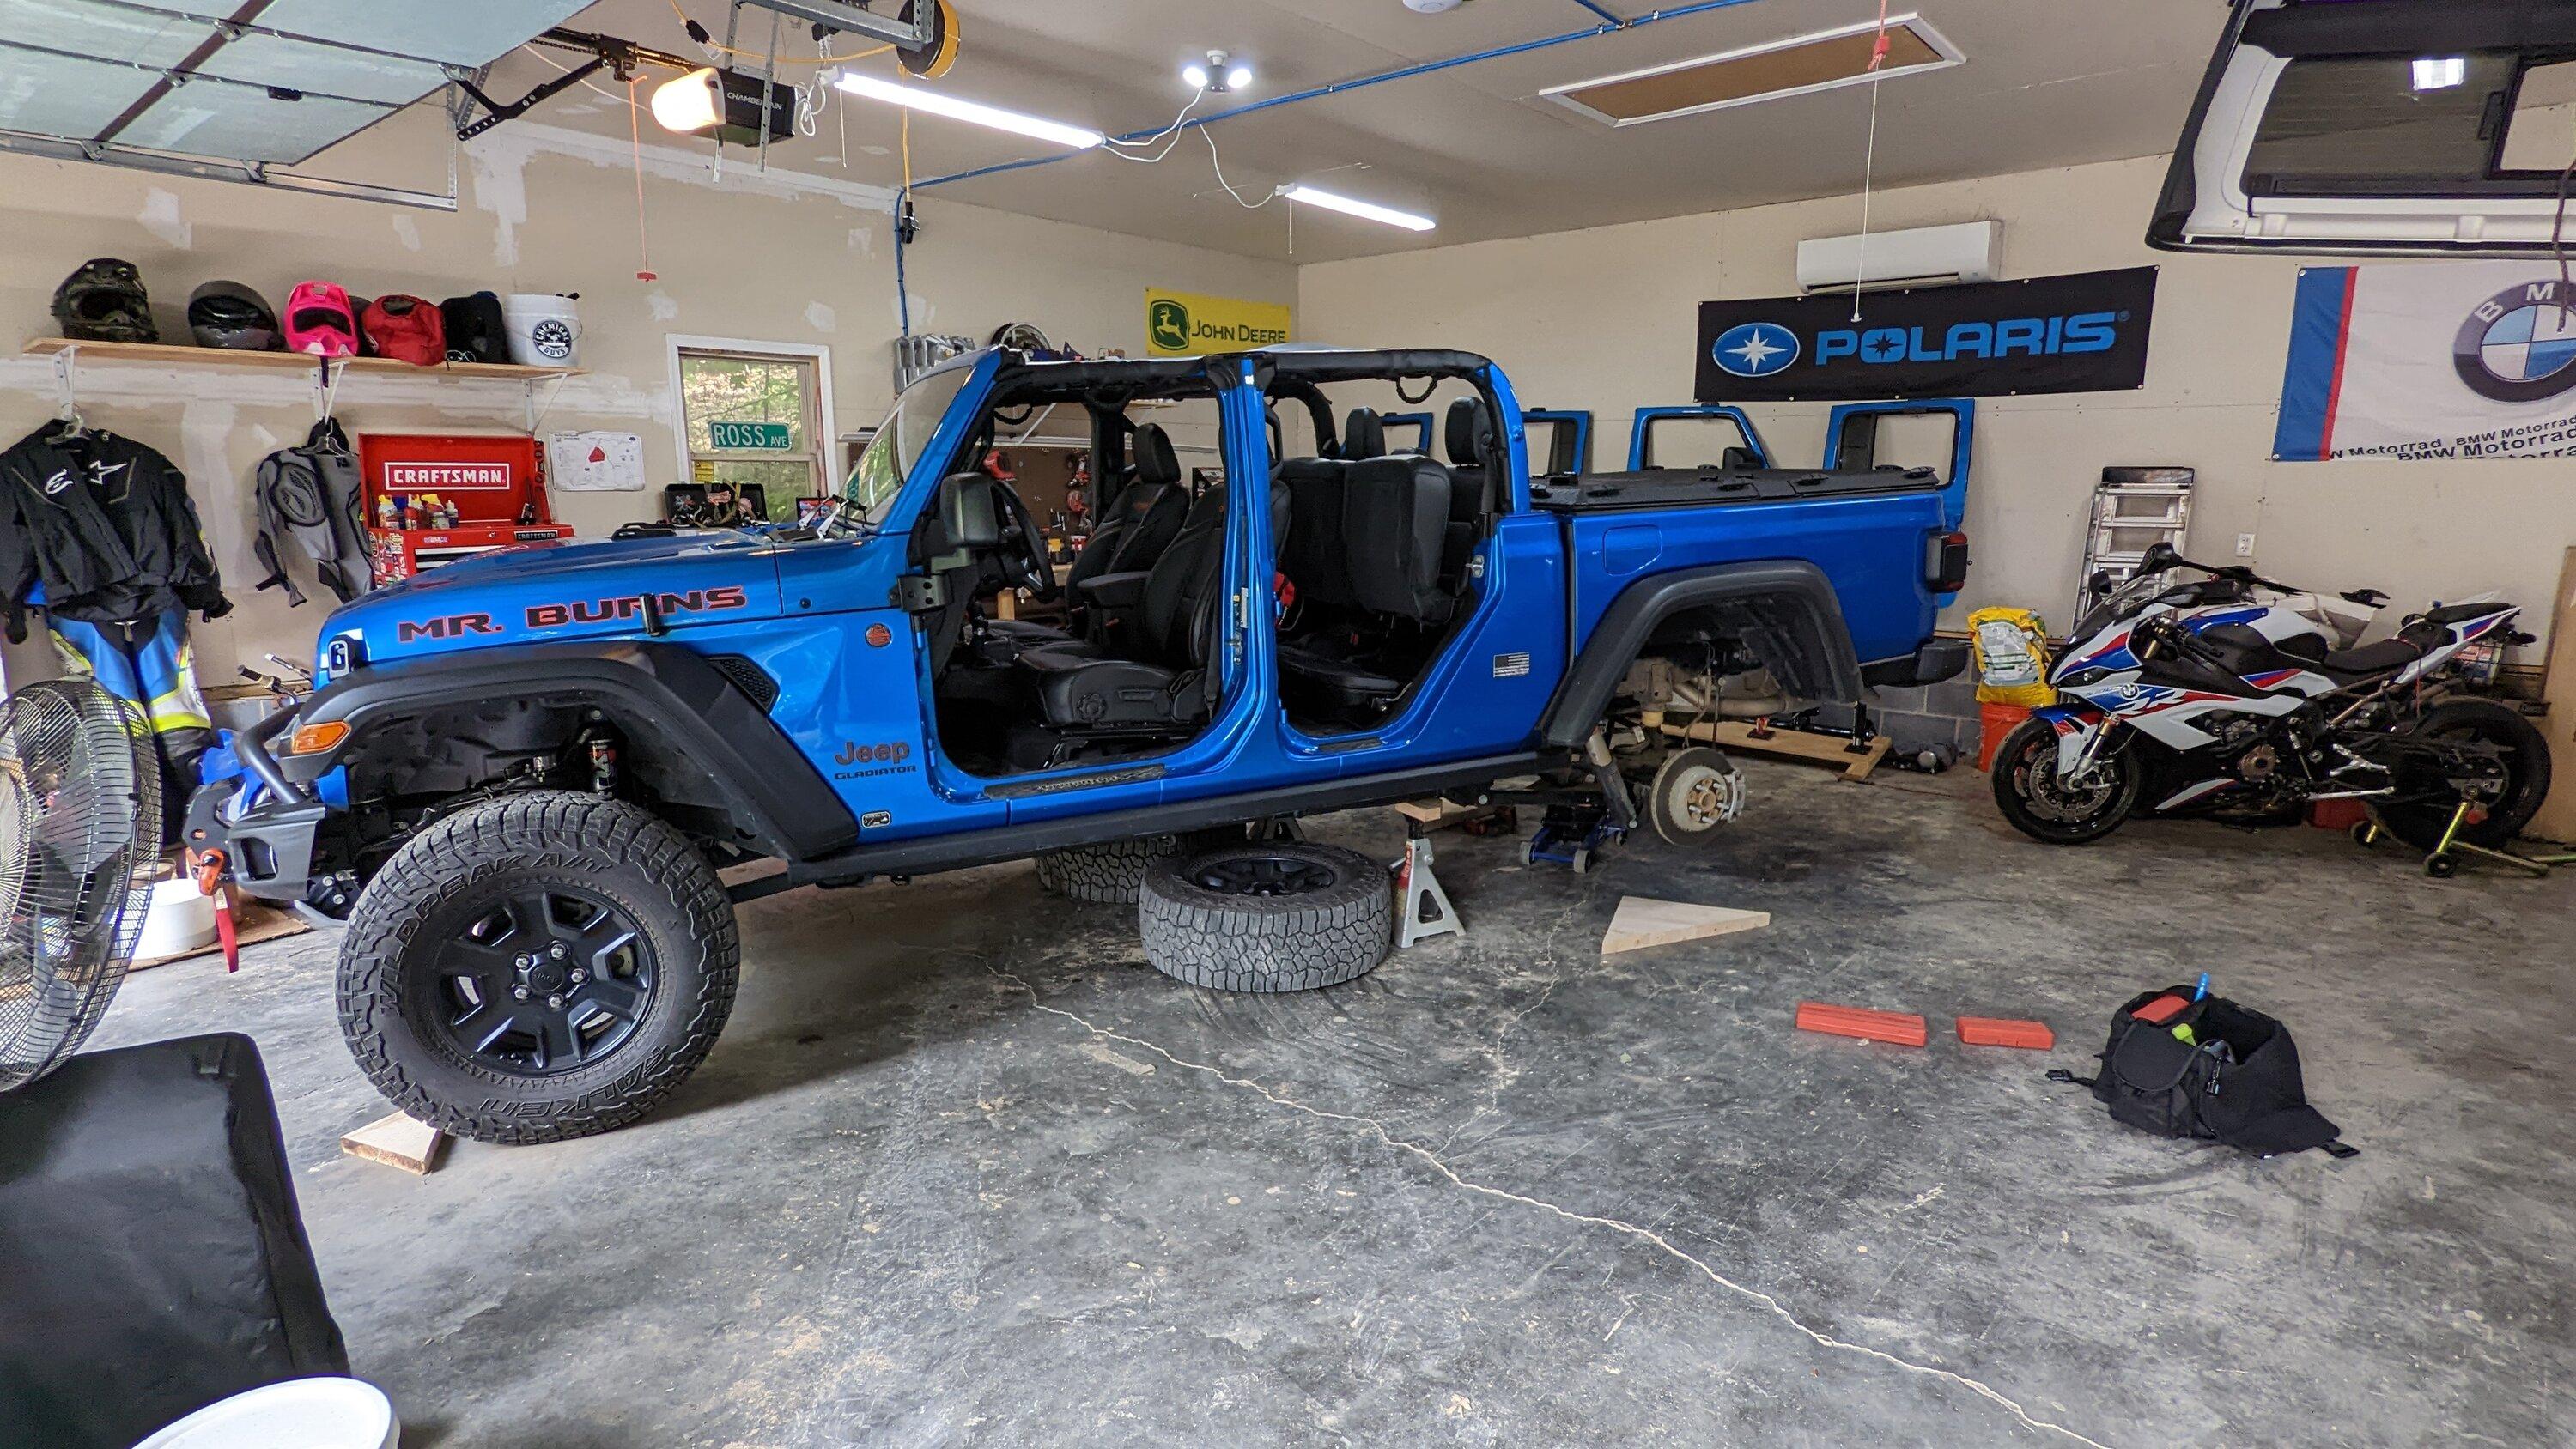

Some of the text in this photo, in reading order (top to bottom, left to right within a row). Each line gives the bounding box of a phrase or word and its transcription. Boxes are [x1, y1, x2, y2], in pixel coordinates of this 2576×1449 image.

[536, 323, 569, 342] CHEMICAL
[1191, 320, 1286, 344] JOHN DEERE
[1815, 312, 2117, 366] POLARIS
[544, 346, 567, 355] GUYS
[713, 424, 787, 447] ROSS AVE
[2456, 432, 2496, 446] BMW
[2349, 438, 2442, 457] Motorrad
[2397, 446, 2455, 461] BMW
[393, 470, 501, 483] CRAFTSMAN
[398, 585, 748, 642] MR. BURNS
[835, 741, 910, 765] Jeep
[834, 765, 917, 780] GLADIATOR
